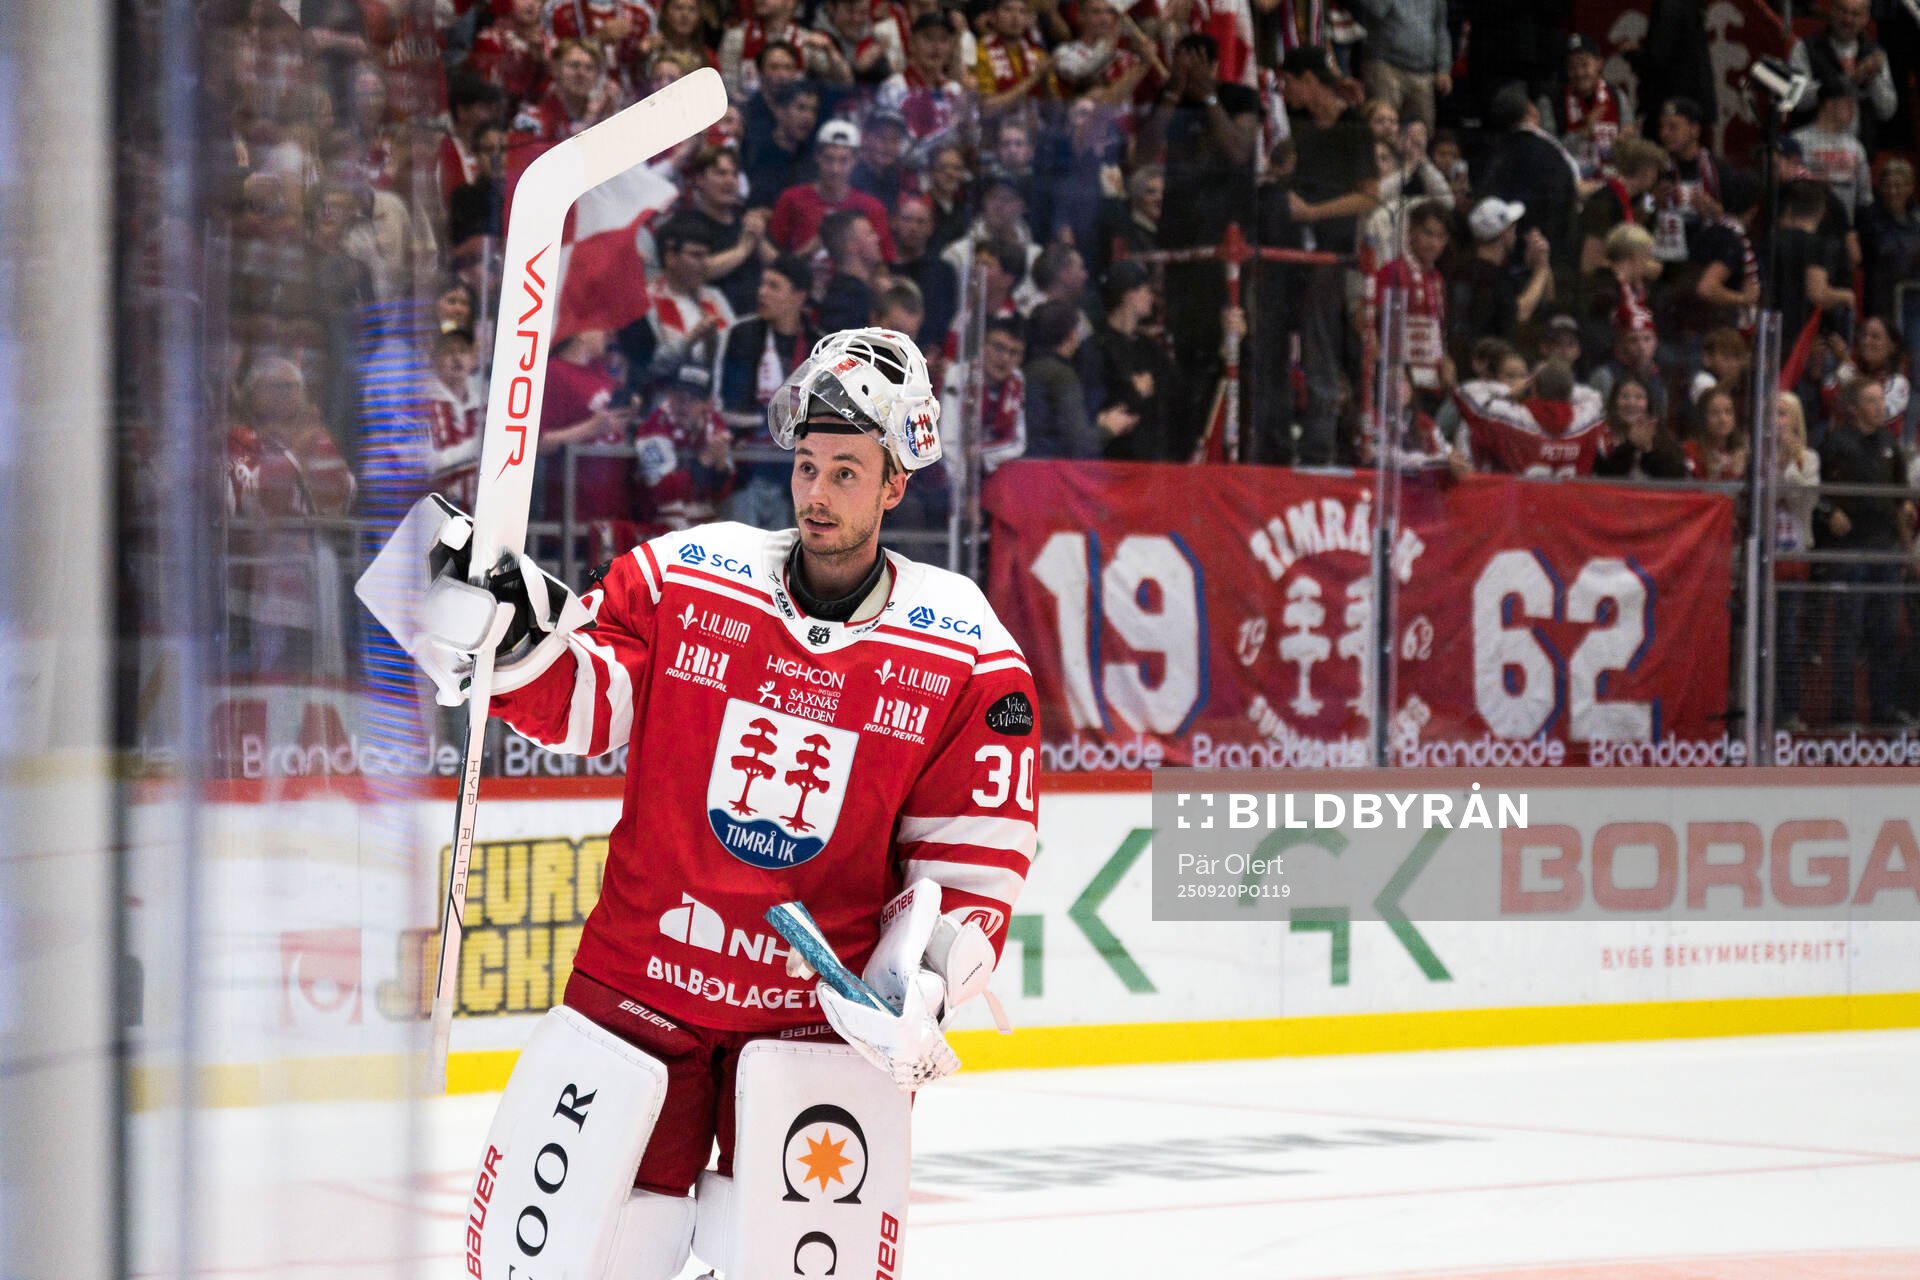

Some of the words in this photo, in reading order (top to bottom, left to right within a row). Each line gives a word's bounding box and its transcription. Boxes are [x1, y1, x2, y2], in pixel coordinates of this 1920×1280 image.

[495, 242, 553, 481] VAPOR
[710, 554, 753, 579] SCA
[700, 611, 751, 643] LILIUM
[939, 616, 982, 640] SCA
[1031, 531, 1204, 736] 19
[1473, 549, 1656, 743] 62
[665, 667, 692, 681] ROAD
[692, 675, 727, 693] RENTAL
[766, 655, 846, 690] HIGHCON
[898, 665, 951, 697] LILIUM
[785, 702, 836, 724] GÅRDEN
[788, 688, 839, 711] SAXNÄS
[863, 723, 891, 735] ROAD
[892, 729, 925, 745] RENTAL
[1040, 733, 1164, 771] ndcode
[971, 745, 1035, 812] 30
[725, 823, 777, 858] TIMRÅ
[777, 839, 798, 863] IK
[1500, 818, 1920, 915] BORGA
[1600, 946, 1653, 970] BYGG
[647, 955, 818, 1009] BILBOLAGET
[780, 1024, 832, 1040] BAUE
[508, 1083, 598, 1280] OOR
